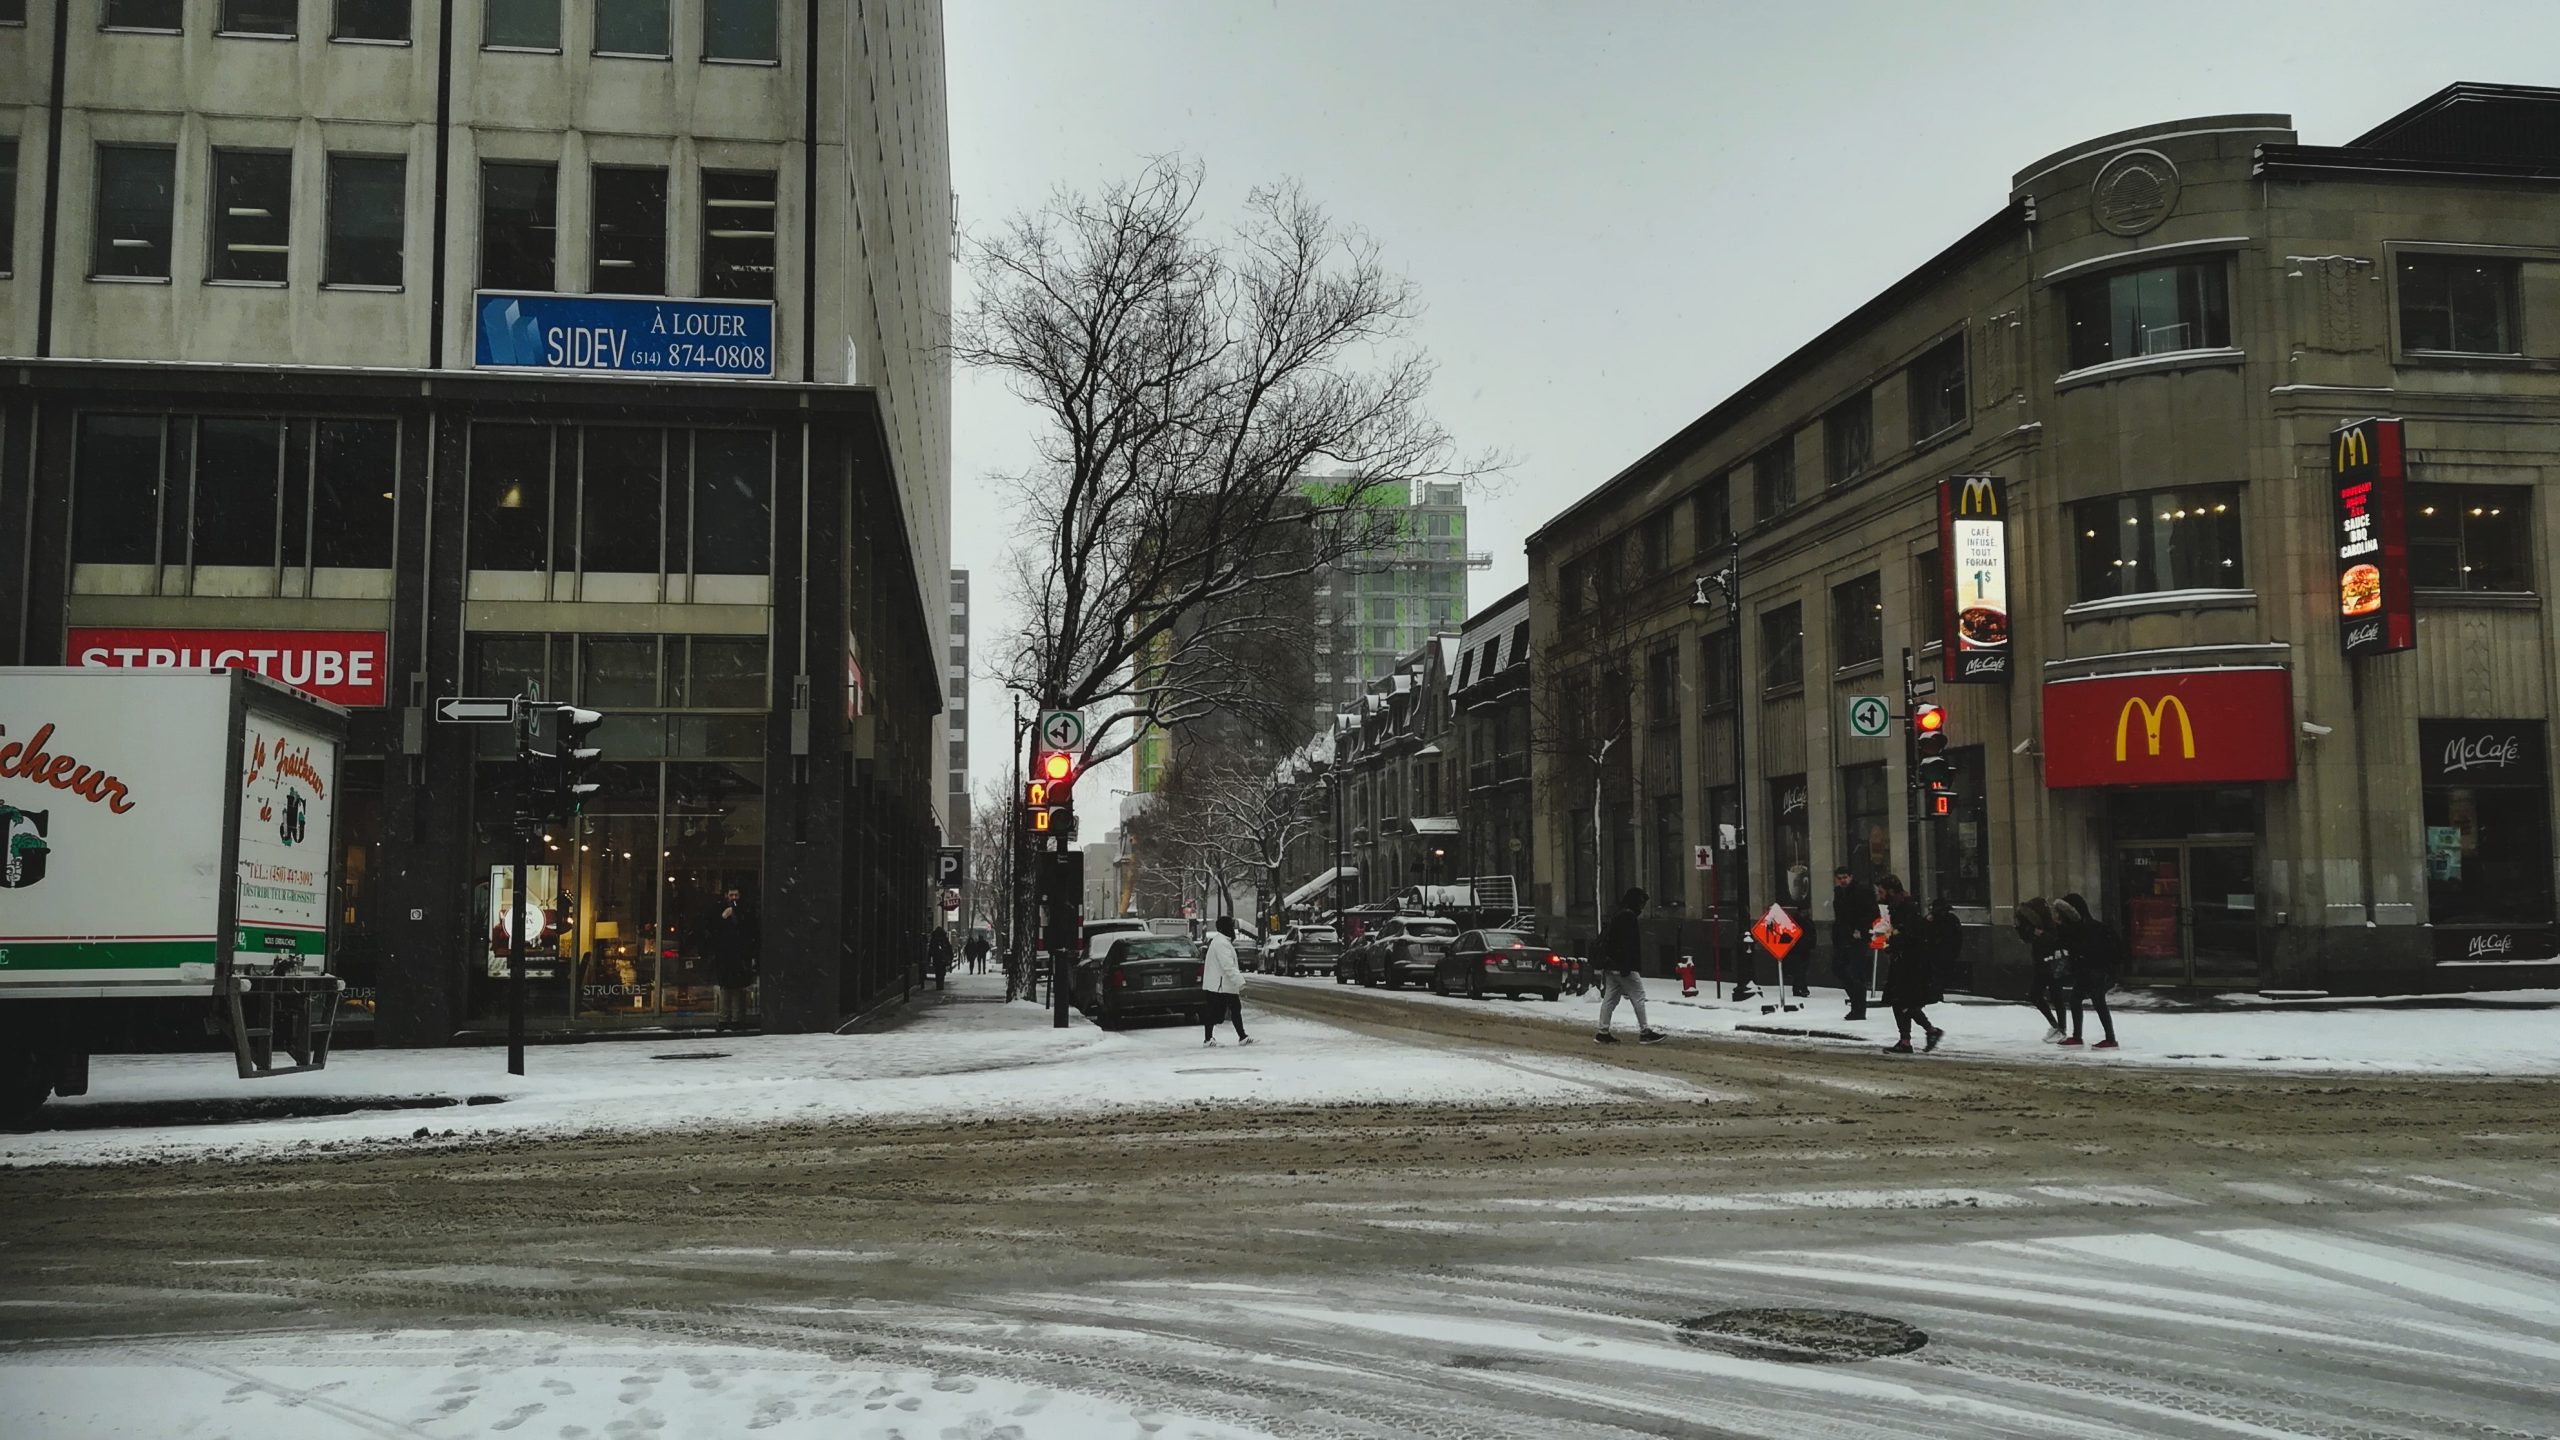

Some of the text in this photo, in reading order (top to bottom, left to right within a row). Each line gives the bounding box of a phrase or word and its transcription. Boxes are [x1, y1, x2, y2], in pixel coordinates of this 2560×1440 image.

[651, 306, 747, 336] À LOUER
[547, 327, 627, 368] SIDEV
[631, 344, 765, 369] (514) 874-0808
[1971, 526, 1990, 536] CAFÉ
[2344, 513, 2371, 532] SAUCE
[2350, 527, 2368, 543] BBQ
[1971, 548, 1991, 557] TOUT
[2340, 538, 2378, 559] CAROLINA
[1966, 558, 1997, 567] FORMAT
[2443, 734, 2520, 773] McCafé
[0, 723, 136, 815] cheur
[940, 856, 958, 879] P
[2469, 934, 2512, 957] McCafé
